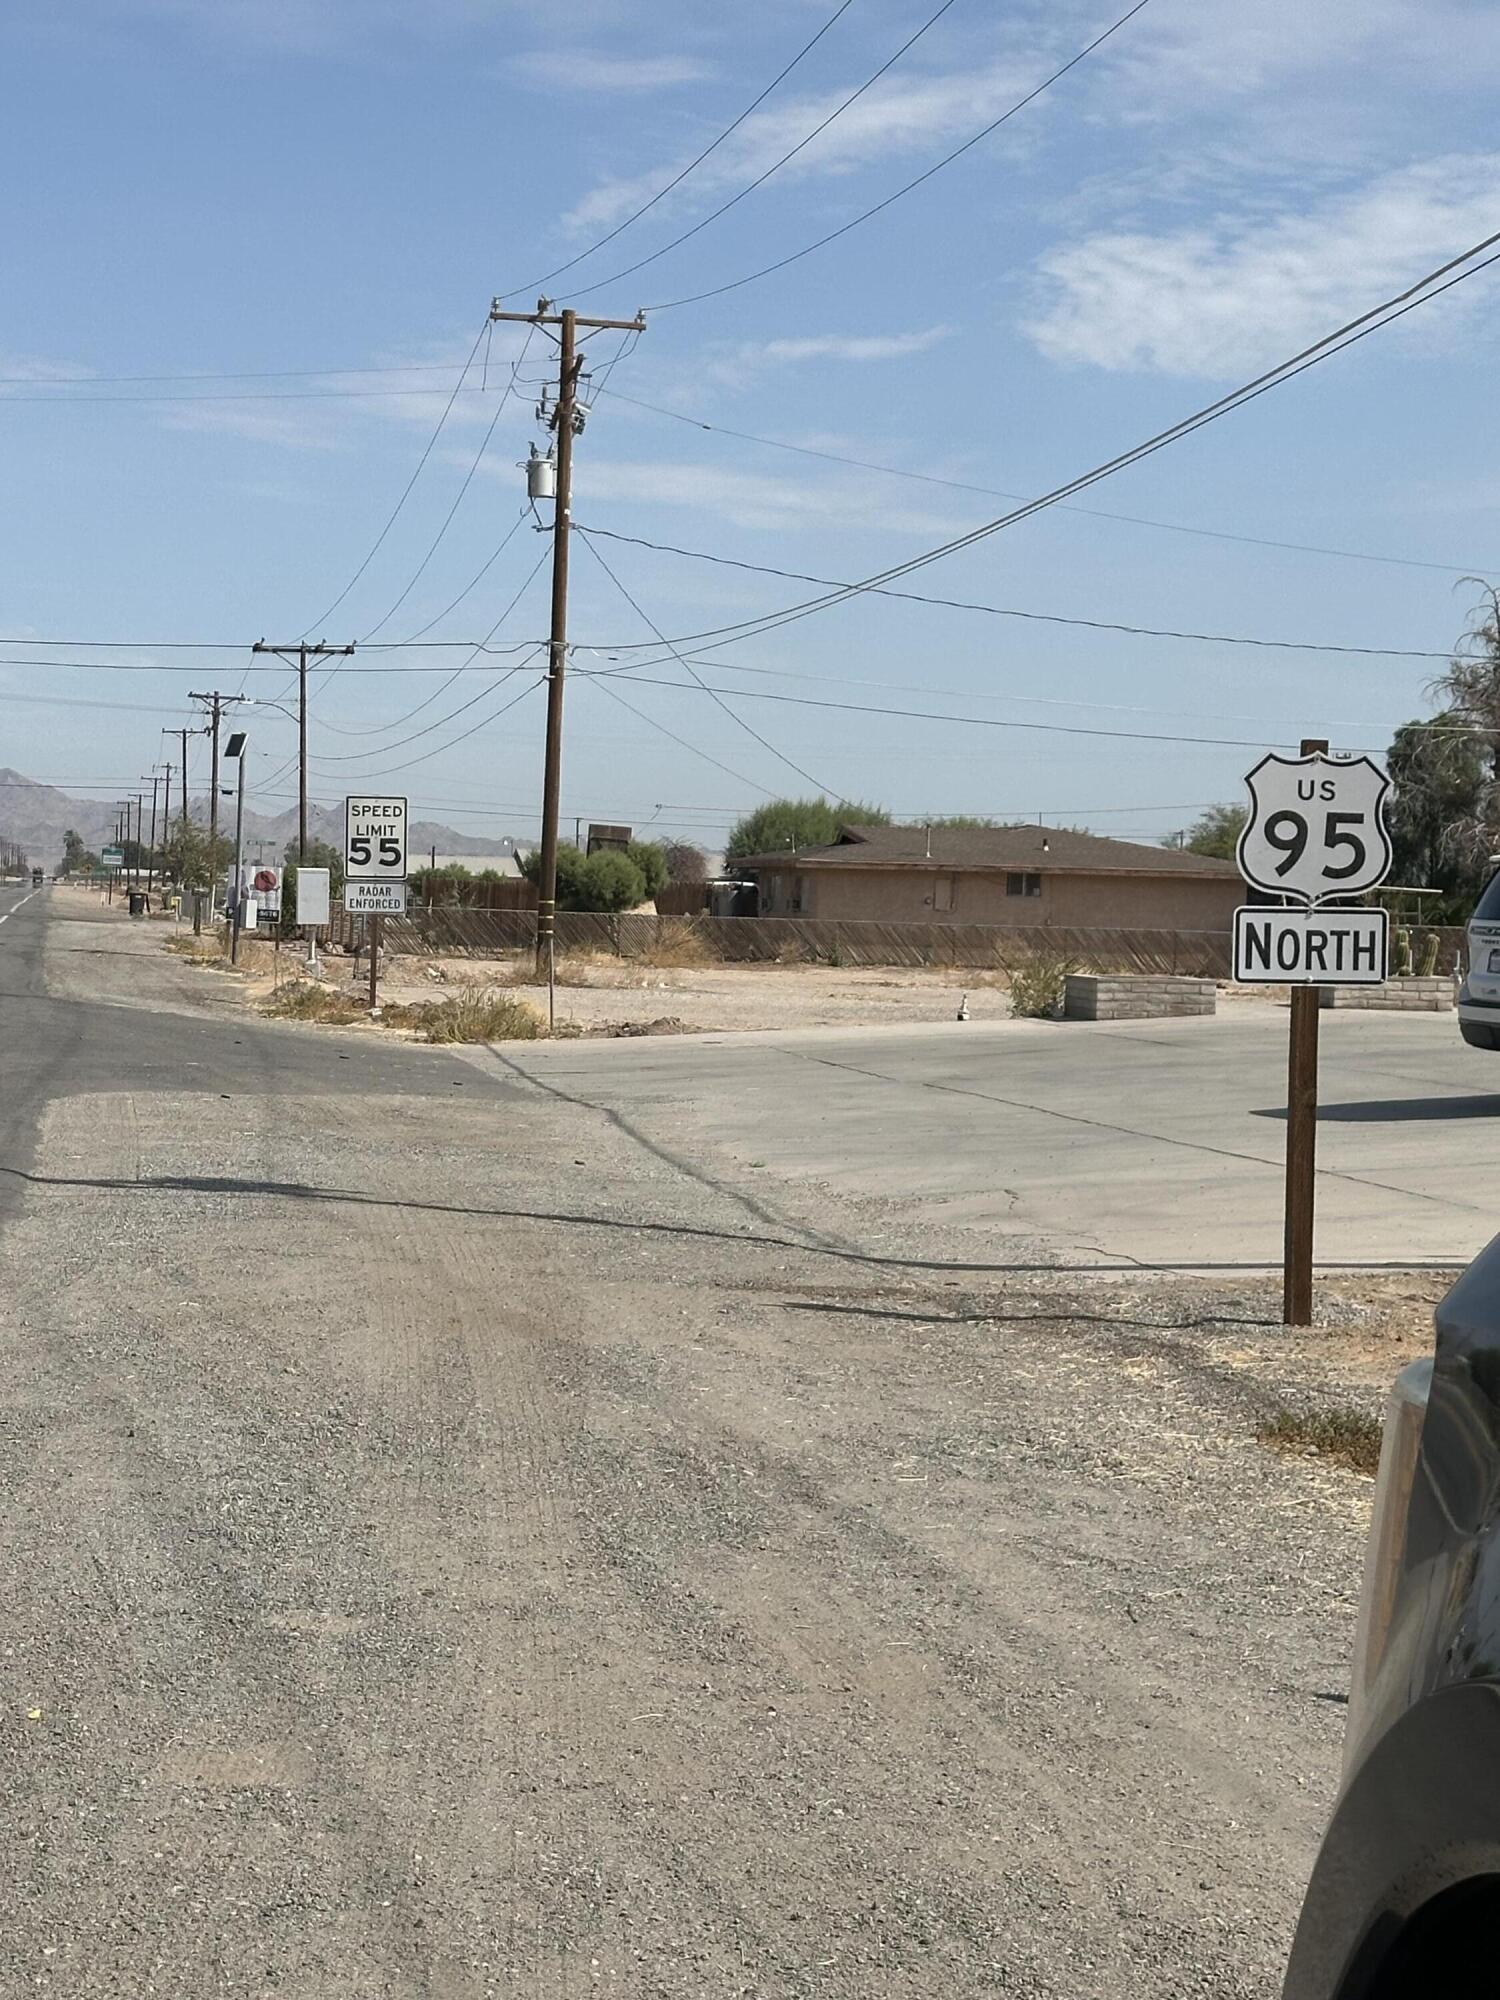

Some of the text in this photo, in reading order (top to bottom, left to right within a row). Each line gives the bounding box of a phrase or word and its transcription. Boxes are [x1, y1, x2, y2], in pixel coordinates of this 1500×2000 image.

[1297, 780, 1336, 800] US
[352, 805, 402, 816] SPEED
[356, 825, 396, 836] LIMIT
[348, 838, 401, 866] 55
[1264, 810, 1366, 879] 95
[359, 887, 391, 896] RADAR
[349, 899, 400, 908] ENFORCED
[1244, 922, 1376, 972] NORTH
